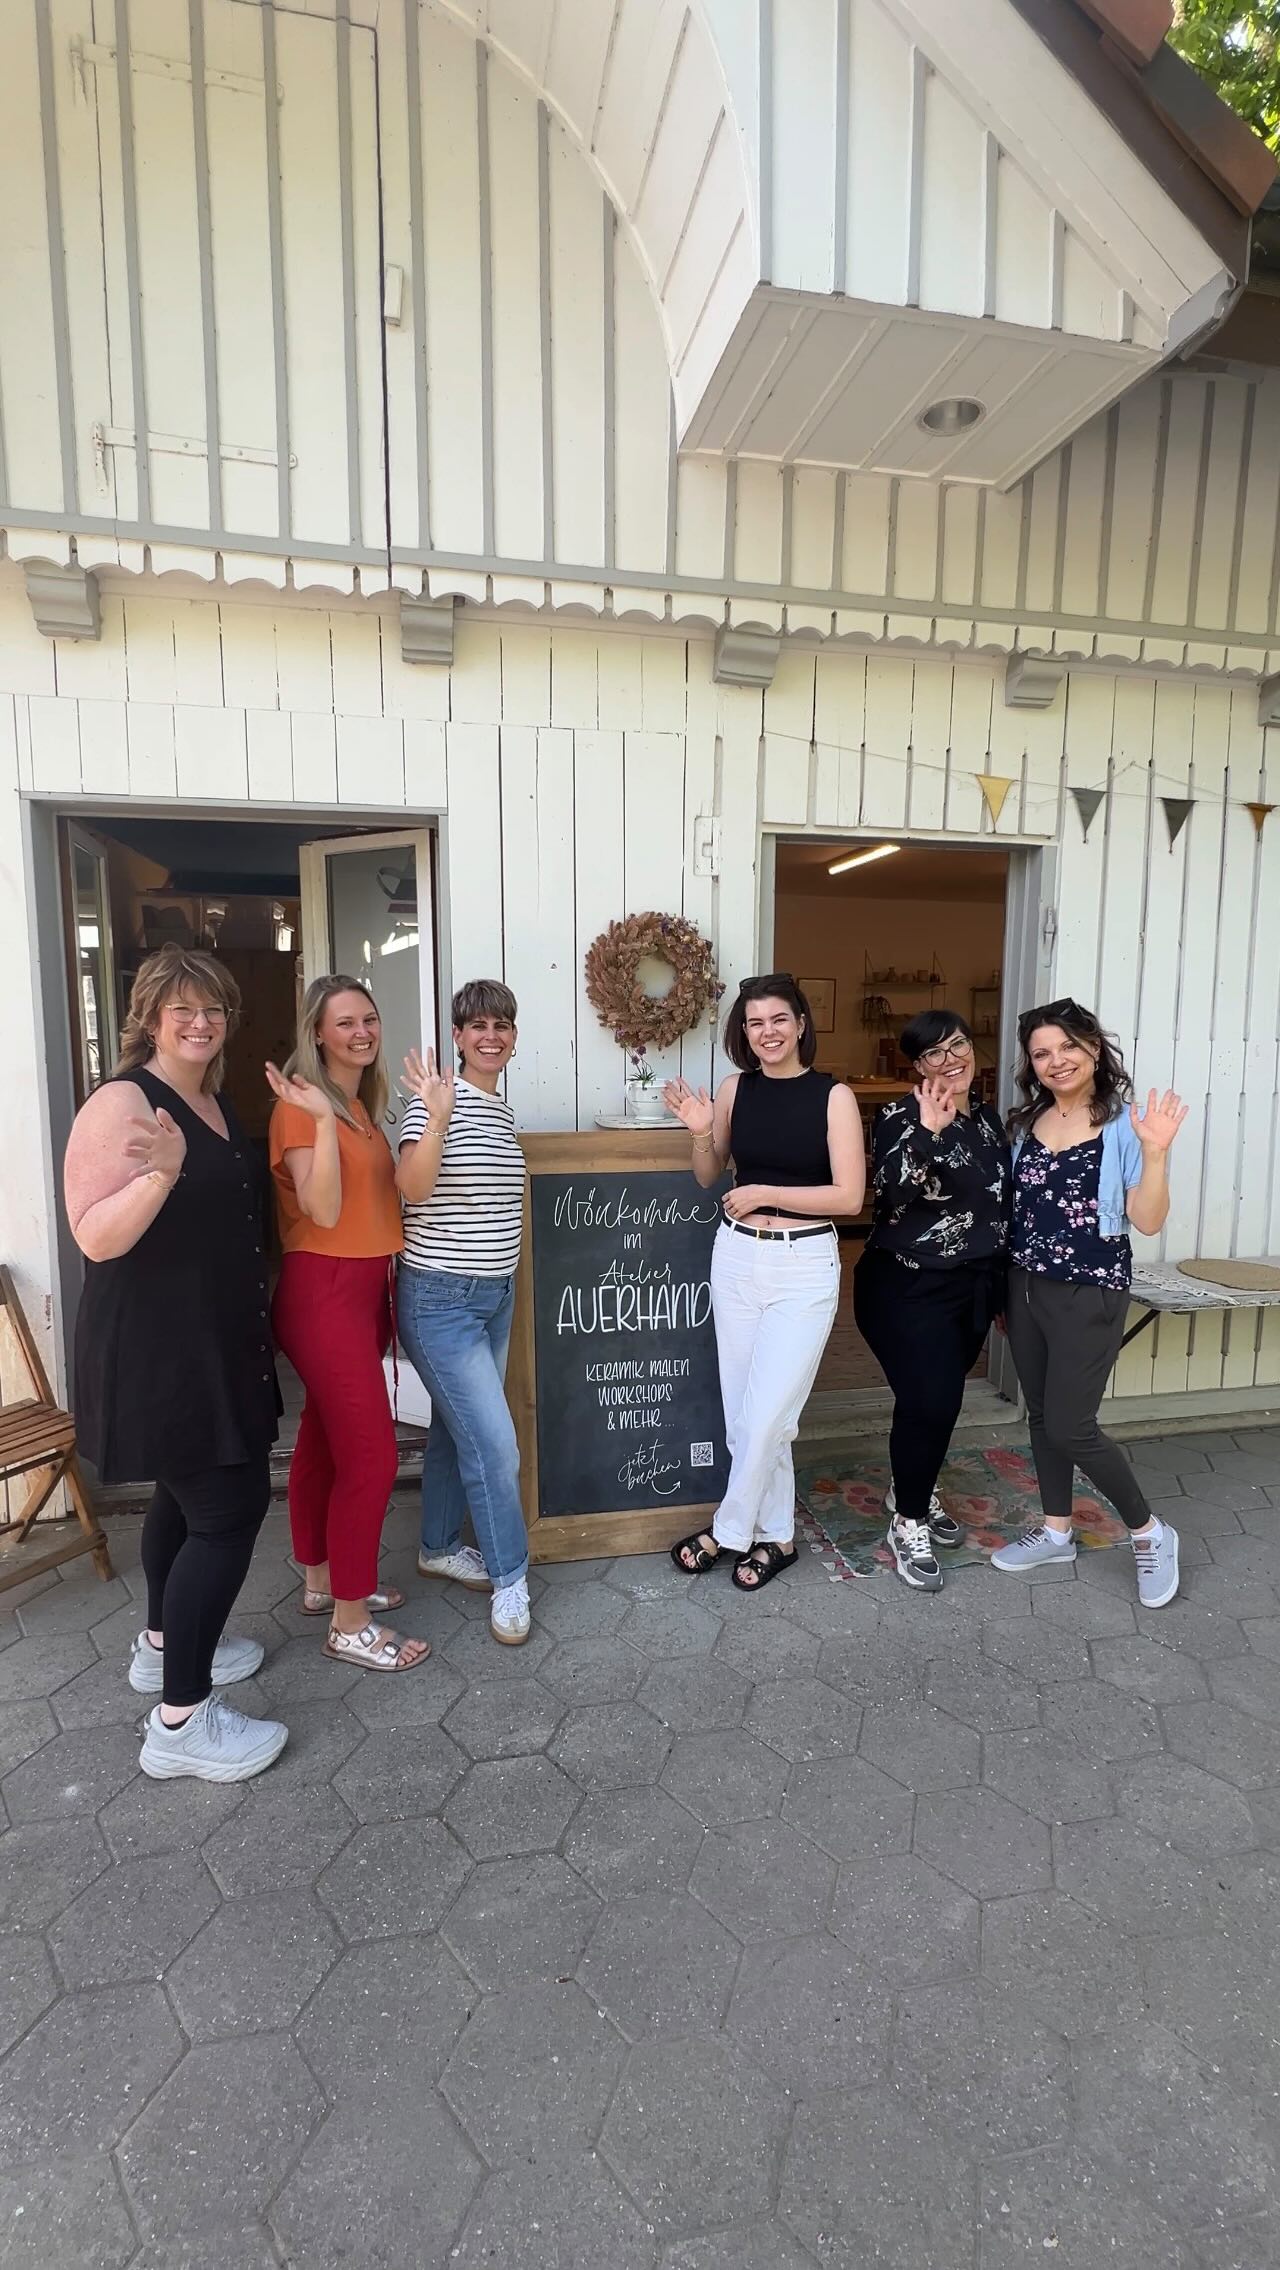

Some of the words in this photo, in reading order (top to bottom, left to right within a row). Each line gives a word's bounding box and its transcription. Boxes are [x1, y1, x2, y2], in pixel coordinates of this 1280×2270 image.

[599, 1259, 672, 1285] Atelier
[557, 1282, 713, 1335] AUERHAND
[586, 1360, 645, 1382] KERAMIK
[650, 1359, 690, 1377] MALEN
[599, 1383, 674, 1407] WORKSHOPS
[607, 1411, 616, 1431] &
[617, 1438, 665, 1483] jetzt
